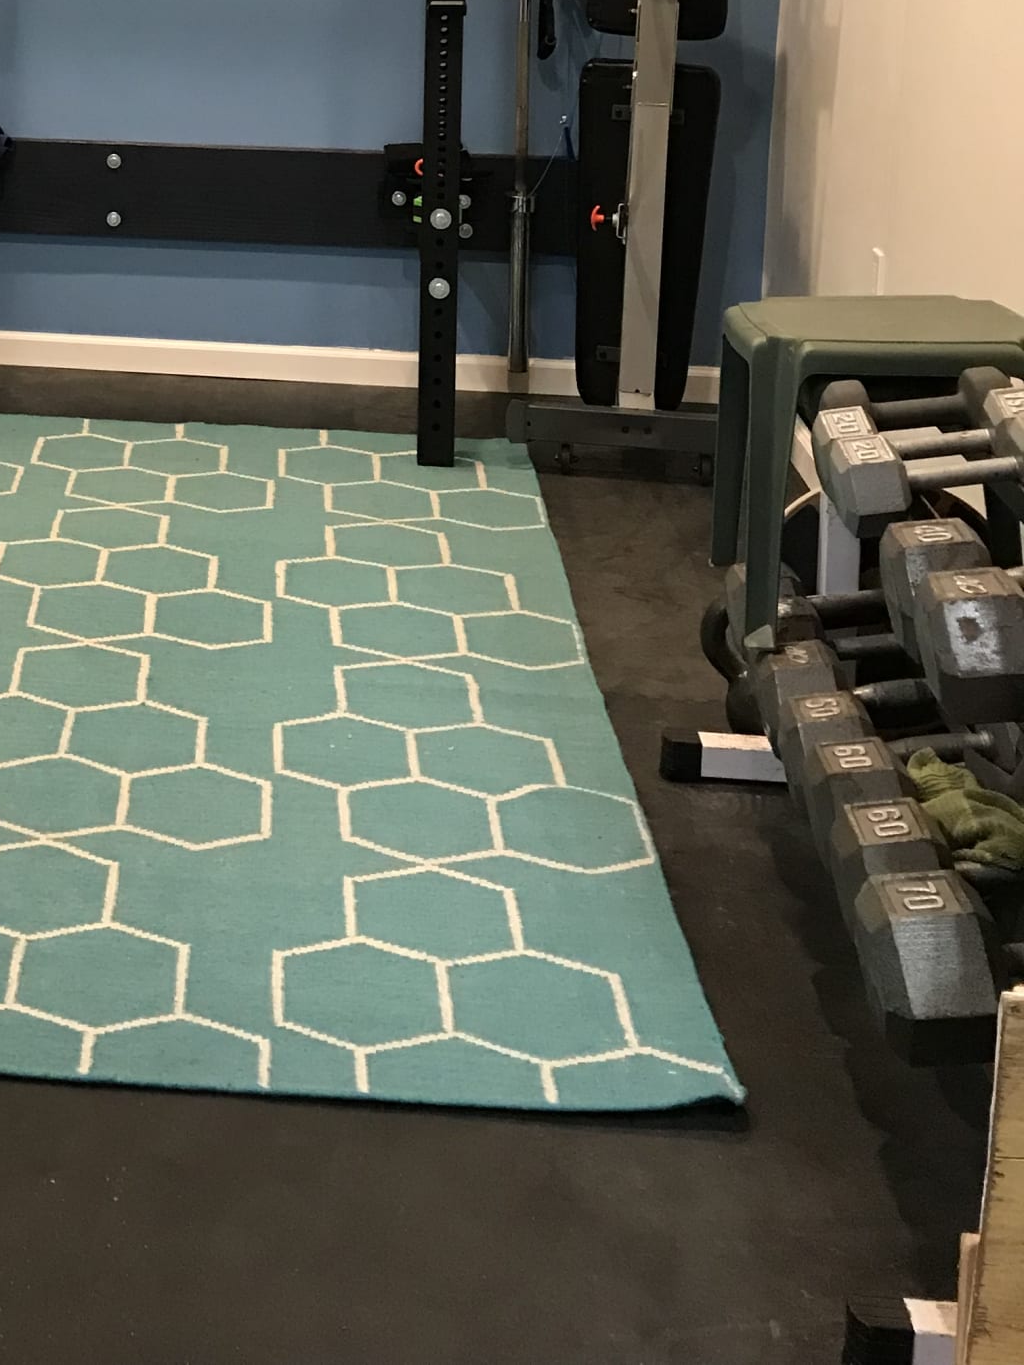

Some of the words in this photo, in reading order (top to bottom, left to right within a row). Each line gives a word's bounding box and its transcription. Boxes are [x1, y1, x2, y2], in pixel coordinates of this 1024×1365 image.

[832, 412, 861, 434] 20
[852, 441, 881, 461] 20
[804, 697, 842, 718] 50
[833, 745, 873, 769] 60
[867, 806, 910, 838] 60
[896, 881, 946, 911] 70
